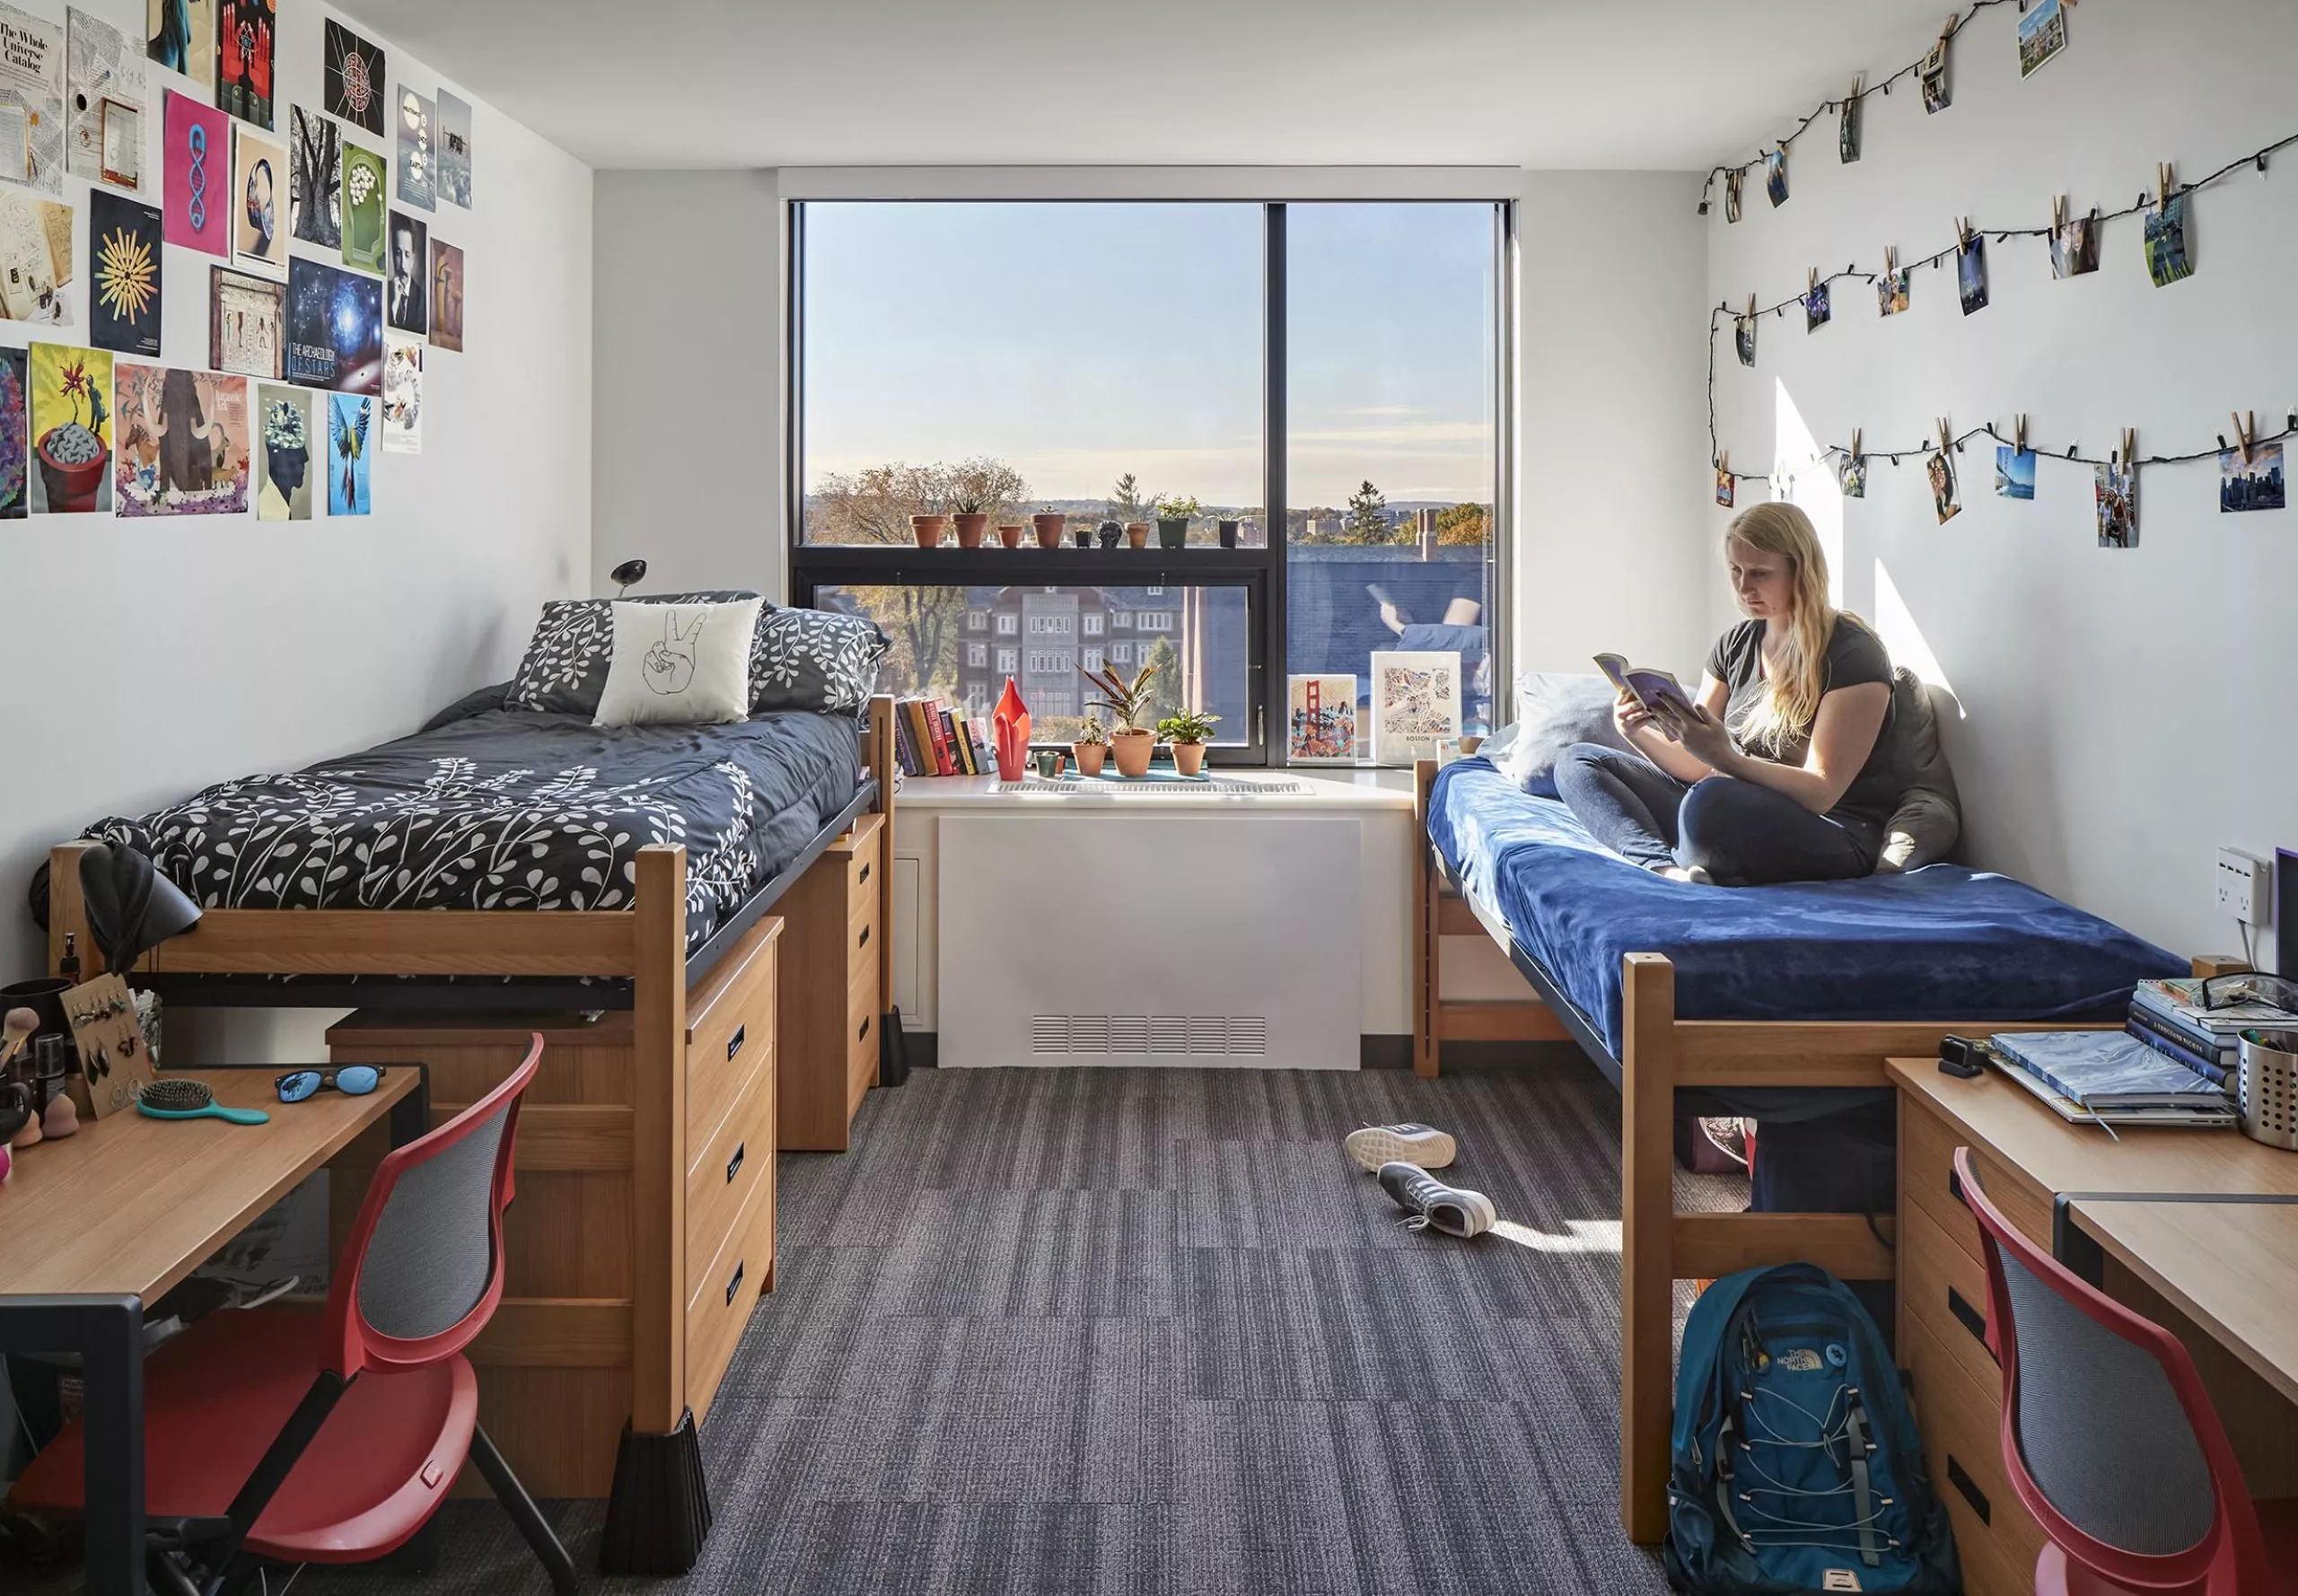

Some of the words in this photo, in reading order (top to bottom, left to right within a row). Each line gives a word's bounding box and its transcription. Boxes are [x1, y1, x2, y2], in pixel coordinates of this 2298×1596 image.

[0, 22, 17, 39] The
[19, 30, 48, 50] Whole
[3, 36, 44, 61] Universe
[4, 49, 41, 75] Catalog
[292, 342, 303, 355] THE
[291, 355, 303, 373] OF
[304, 357, 336, 378] STARS
[1776, 1356, 1807, 1365] NORTH
